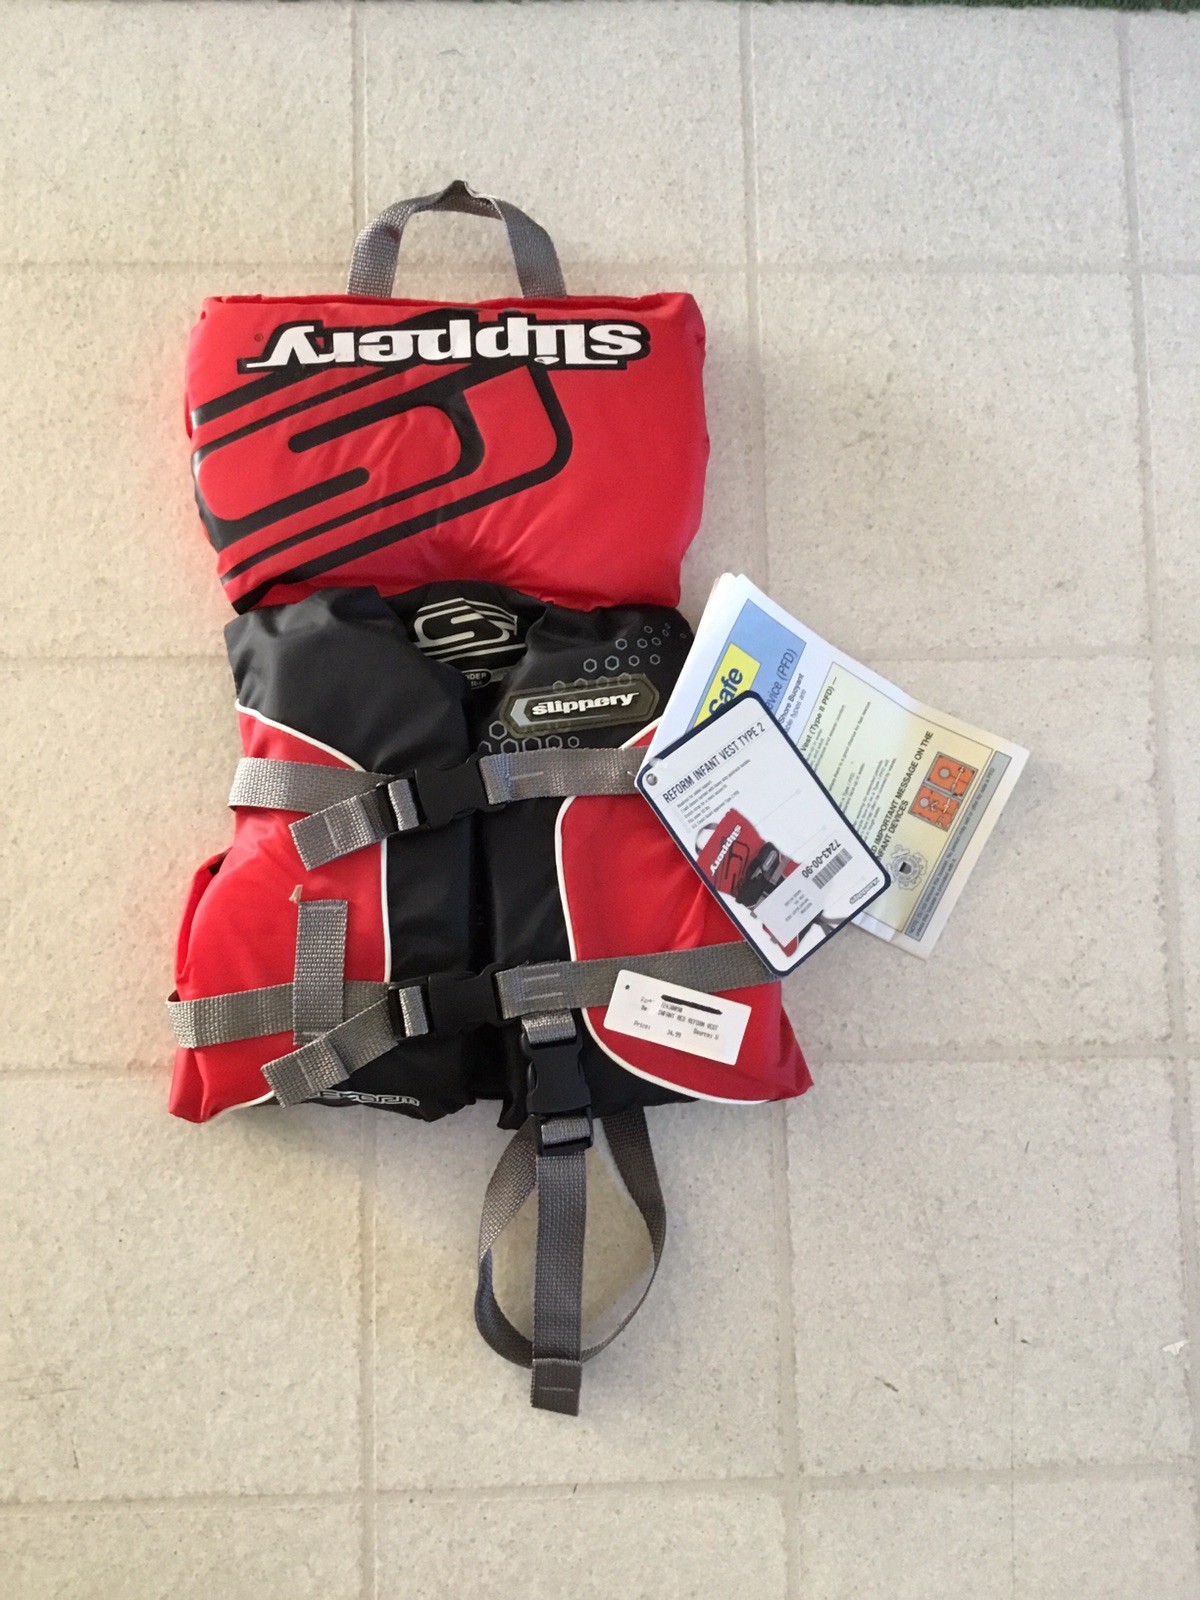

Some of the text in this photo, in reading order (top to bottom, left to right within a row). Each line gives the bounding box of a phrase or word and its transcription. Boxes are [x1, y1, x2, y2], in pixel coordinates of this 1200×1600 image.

[246, 317, 642, 365] slippery
[532, 693, 639, 715] slippery
[765, 648, 797, 708] evice (PFD)
[778, 702, 791, 723] Shore
[801, 735, 811, 751] Vest
[809, 712, 822, 734] (Type
[821, 686, 833, 704] PFD)
[663, 776, 693, 802] REFORM
[693, 756, 720, 779] INFANT
[719, 741, 739, 759] VEST
[738, 727, 757, 745] TYPE
[756, 722, 764, 731] 2
[873, 800, 898, 844] IMPORTANT
[895, 761, 917, 799] MESSAGE
[914, 747, 924, 761] ON
[921, 731, 933, 747] THE
[801, 839, 840, 877] 7243-00-90
[875, 799, 908, 860] NFANT DEVICES
